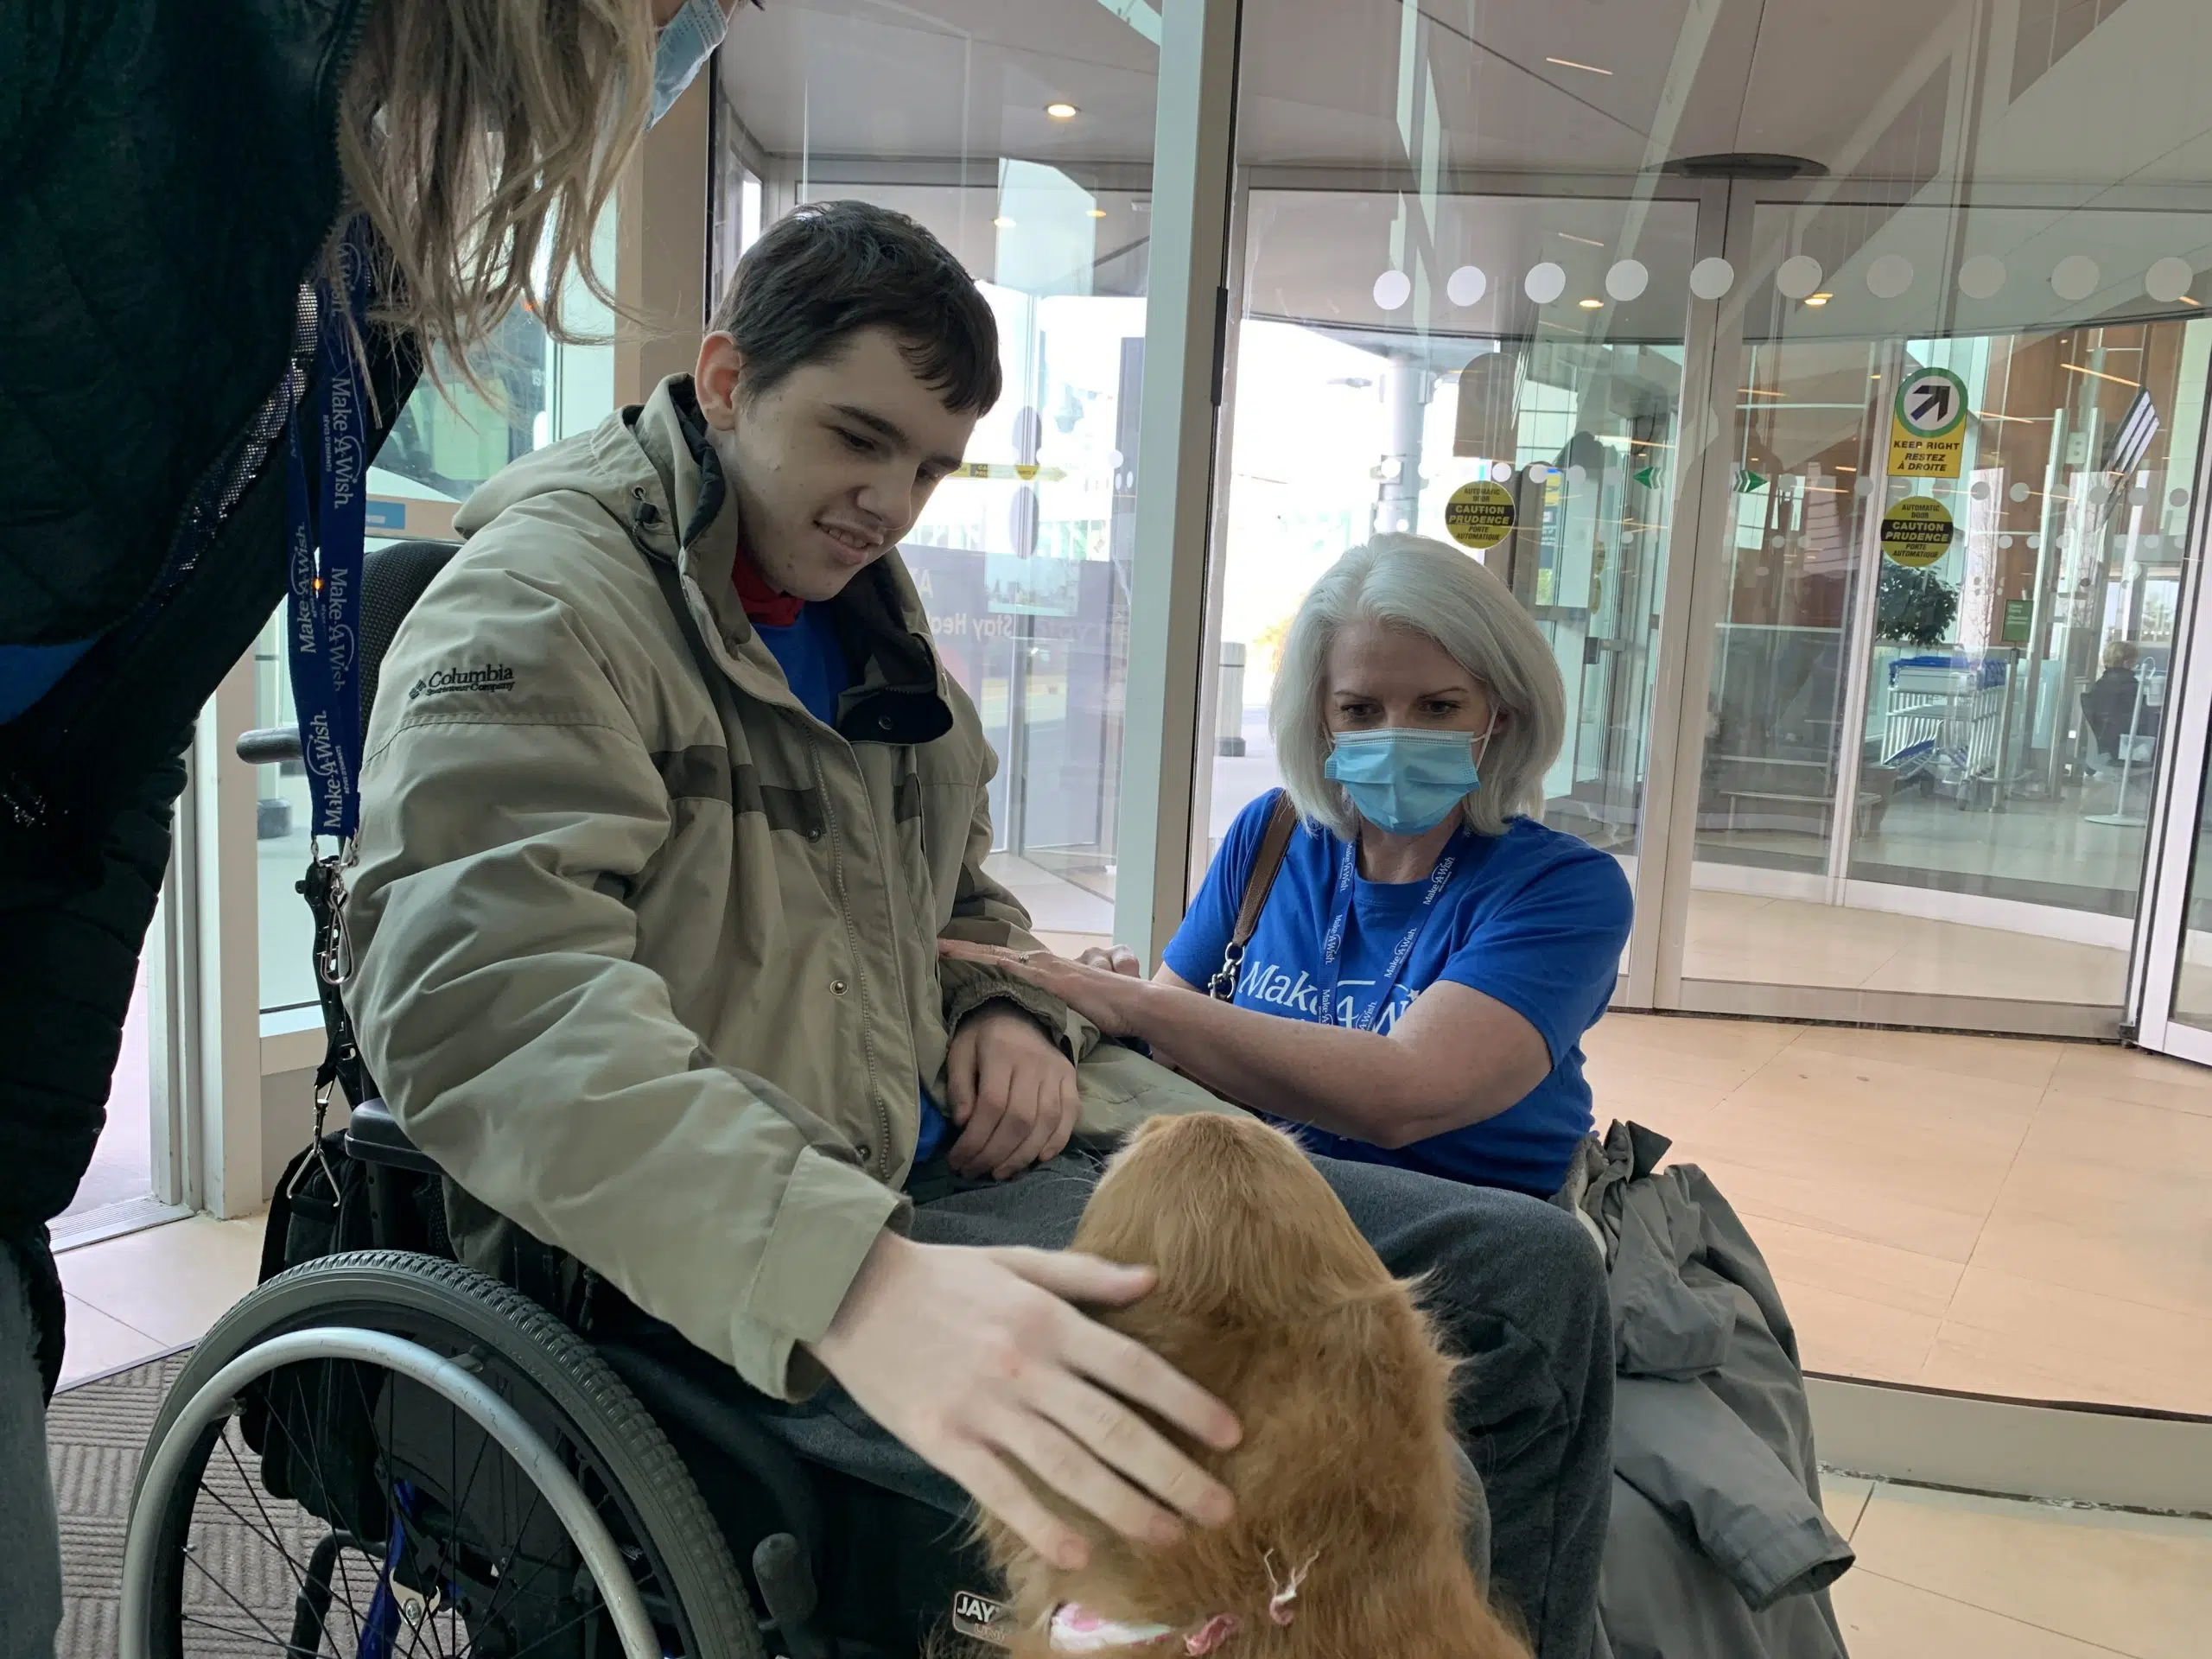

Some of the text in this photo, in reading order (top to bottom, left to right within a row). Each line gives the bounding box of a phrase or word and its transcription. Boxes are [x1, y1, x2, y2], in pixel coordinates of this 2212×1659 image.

[1893, 440, 1961, 450] KEEP RIGHT
[1904, 453, 1946, 461] RESTEZ
[1907, 462, 1948, 472] DROITE
[1455, 505, 1504, 514] CAUTION
[1902, 504, 1940, 512] AUTOMATIC
[1448, 515, 1510, 524] PRUDENCE
[1892, 521, 1944, 531] CAUTION
[1885, 531, 1949, 542] PRUDENCE
[428, 664, 514, 688] Columbia
[470, 682, 515, 692] Company
[957, 1596, 995, 1623] JAY
